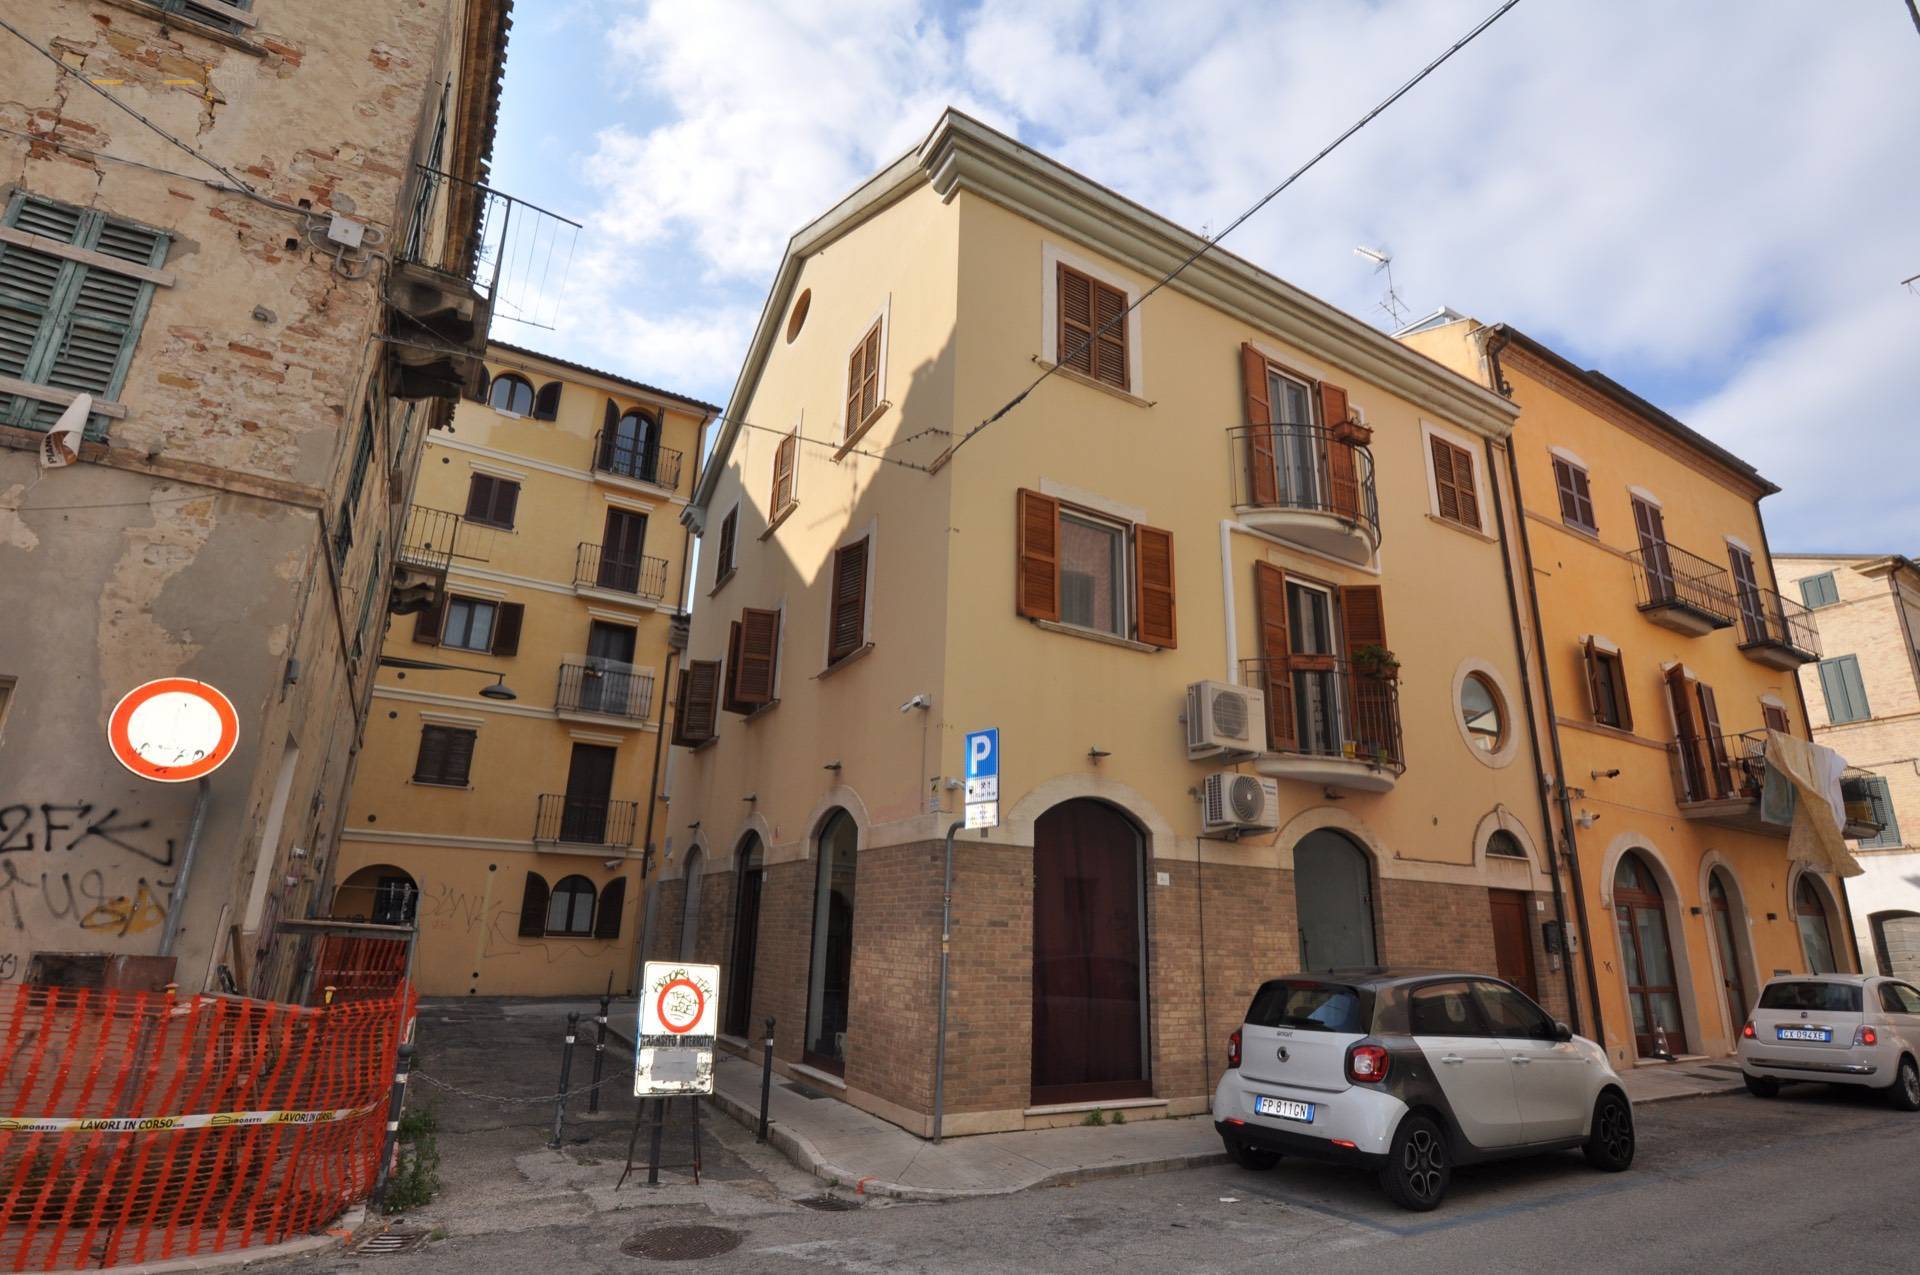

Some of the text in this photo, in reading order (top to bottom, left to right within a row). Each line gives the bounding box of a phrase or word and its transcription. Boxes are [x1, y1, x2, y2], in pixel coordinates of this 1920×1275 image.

[971, 735, 992, 775] P
[1262, 1099, 1307, 1118] FP 811GN
[80, 1120, 120, 1130] LAVORI
[122, 1119, 136, 1130] IN
[138, 1119, 173, 1129] CORSO
[279, 1112, 307, 1122] LAVORI
